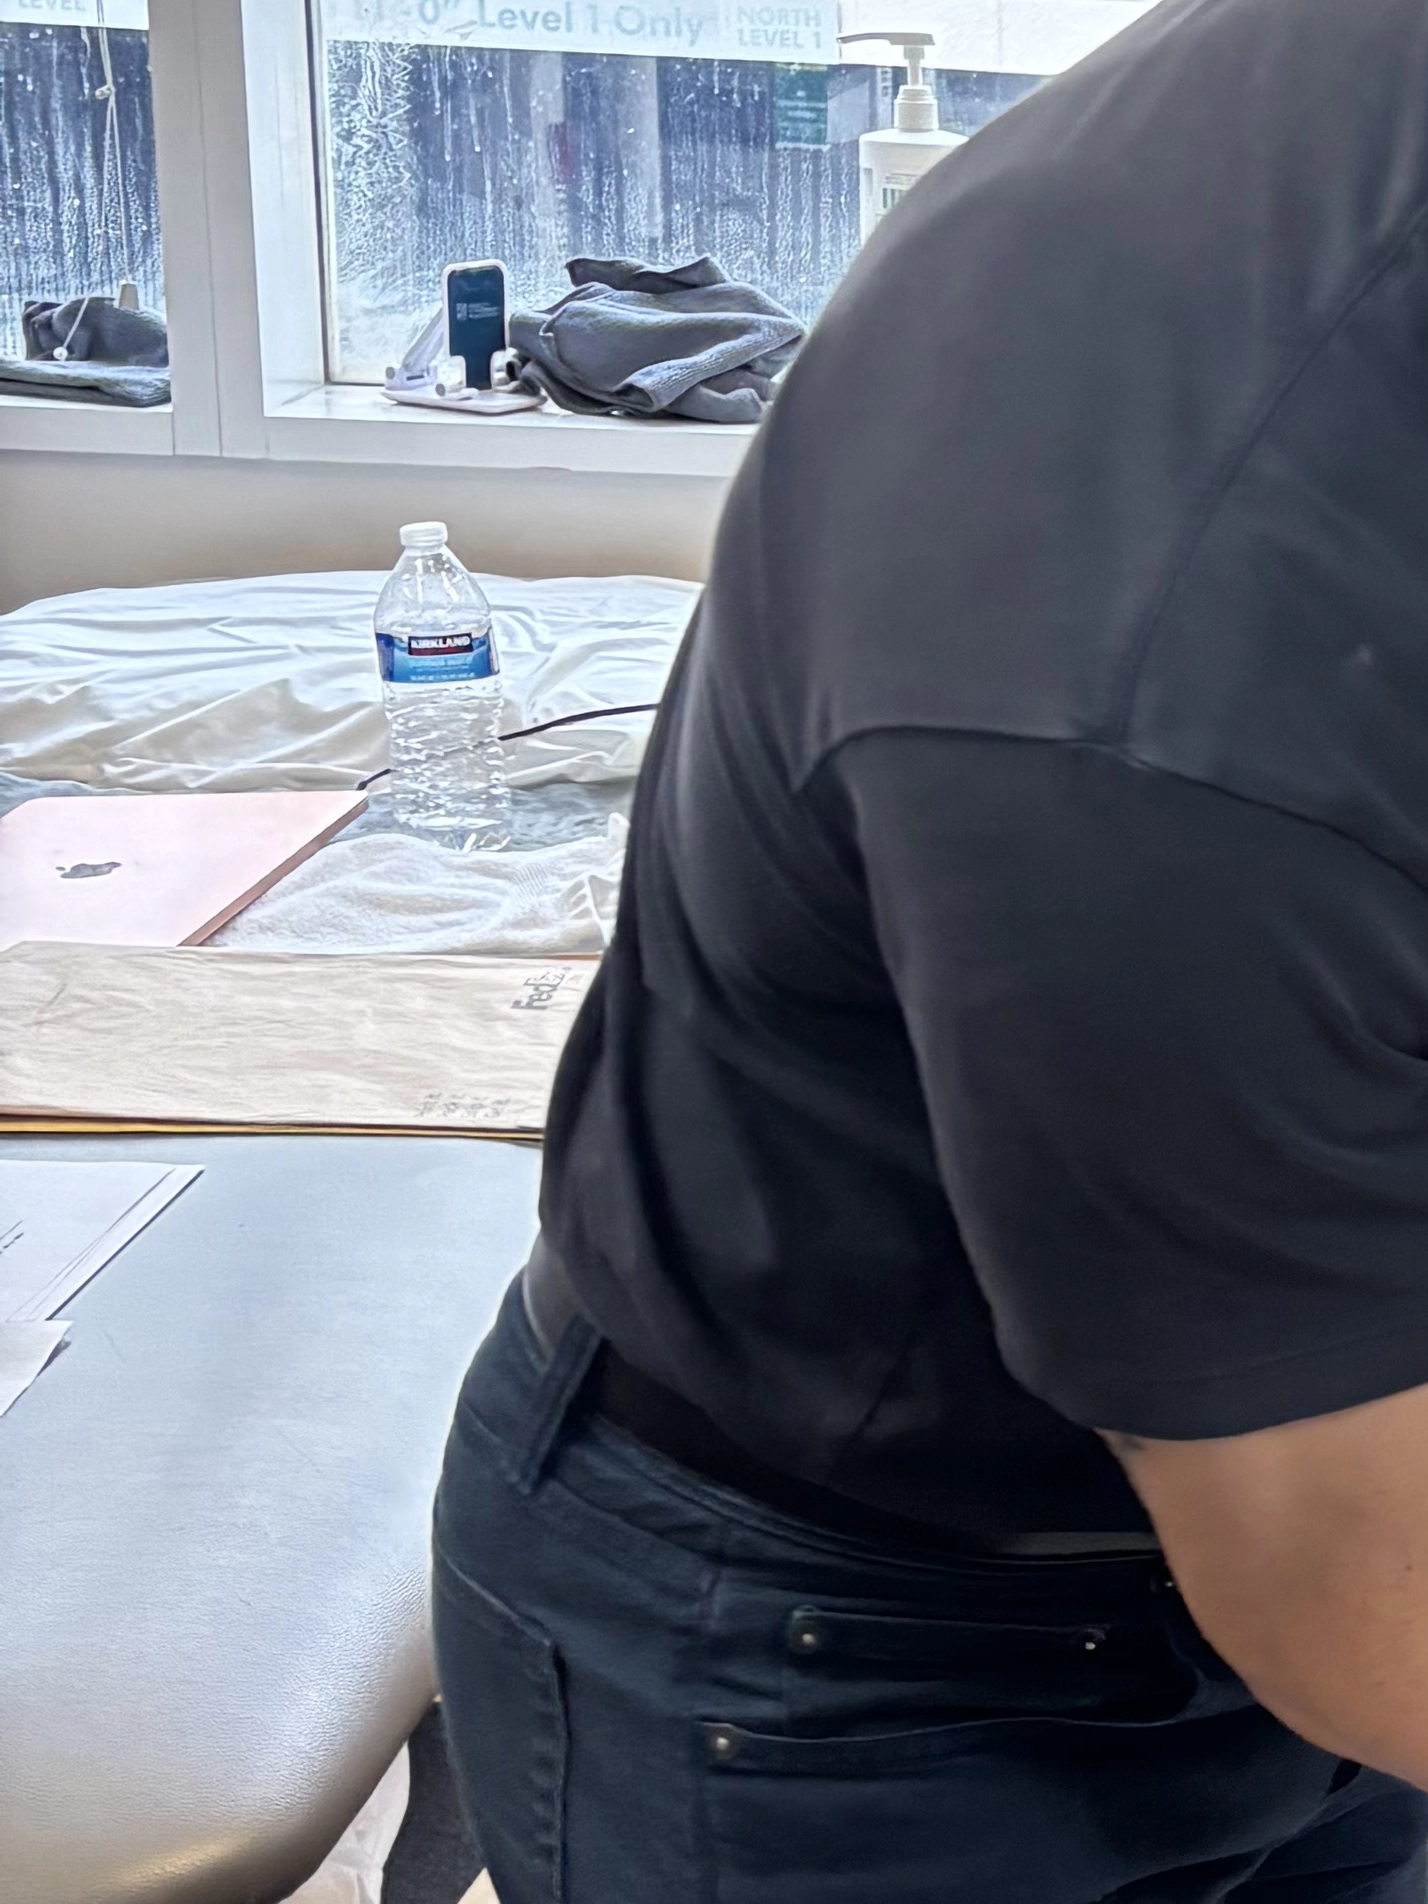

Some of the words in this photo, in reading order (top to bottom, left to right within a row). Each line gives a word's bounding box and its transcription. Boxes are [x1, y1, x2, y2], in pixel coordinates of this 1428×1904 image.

[585, 3, 599, 35] 1
[613, 4, 704, 48] Only
[736, 5, 823, 28] NORTH
[737, 27, 805, 50] LEVEL
[813, 30, 822, 50] 1
[410, 635, 471, 649] KIRKLAND
